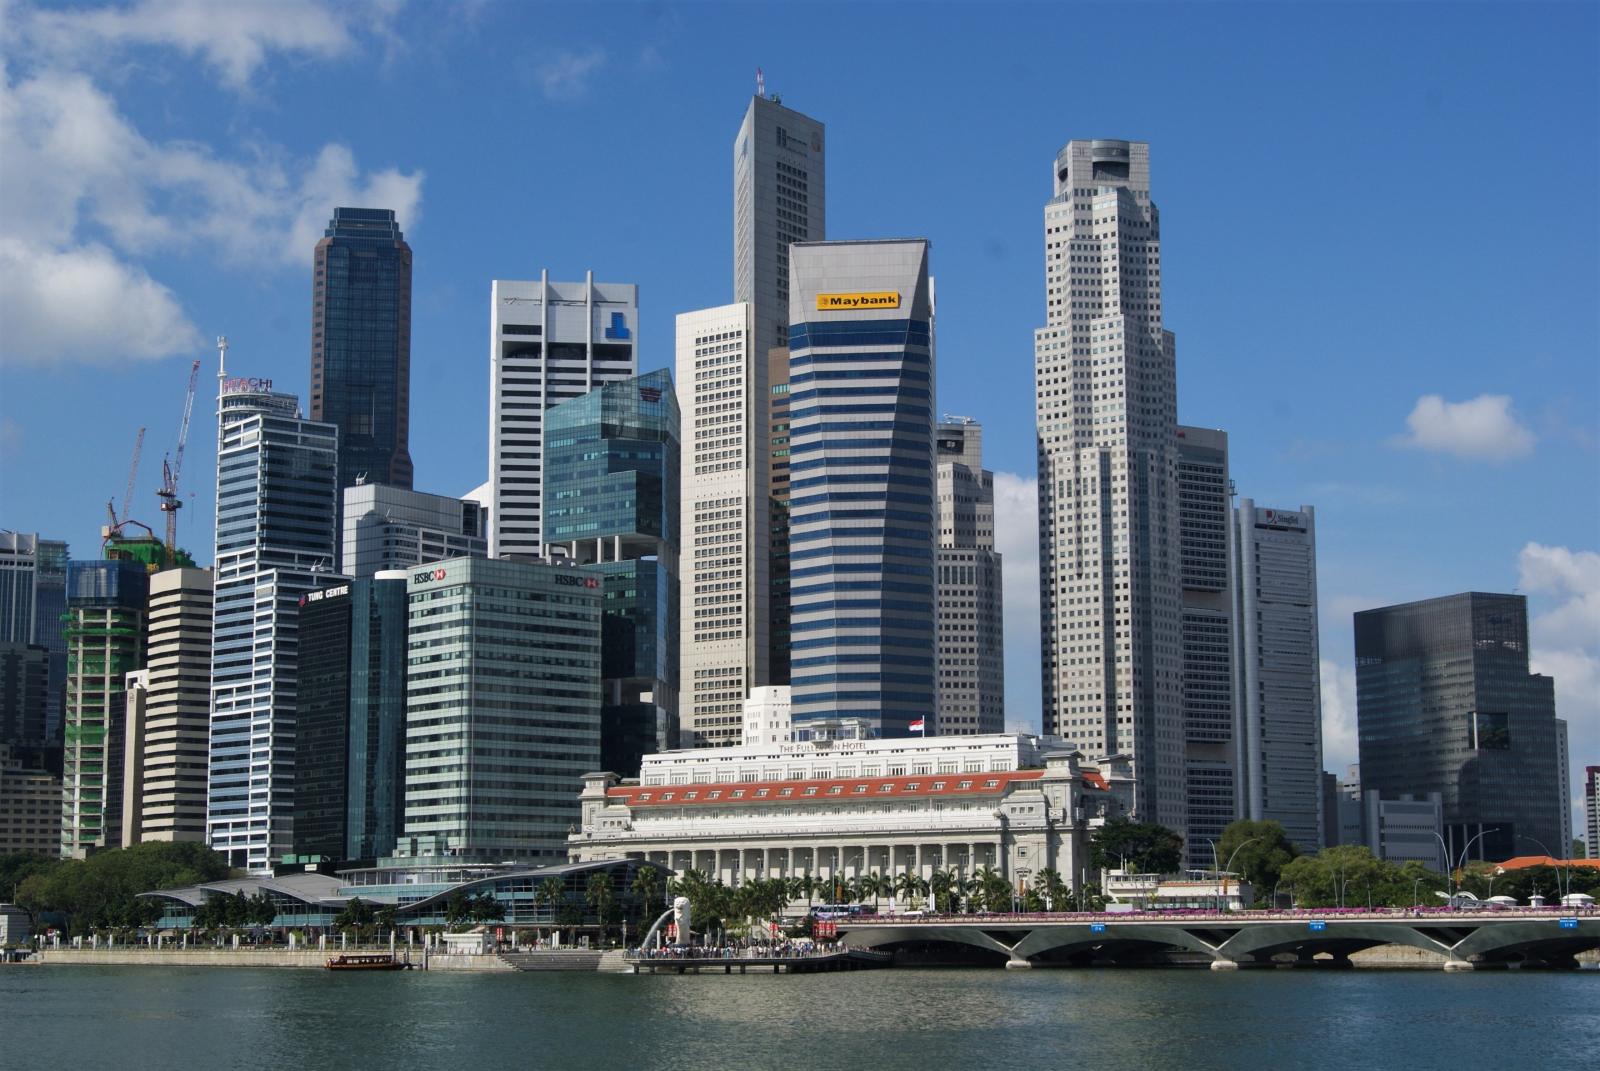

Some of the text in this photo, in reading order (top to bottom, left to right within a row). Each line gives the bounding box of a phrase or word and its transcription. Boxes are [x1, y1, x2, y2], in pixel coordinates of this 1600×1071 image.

[830, 296, 896, 306] Maybank
[223, 377, 272, 390] HITACHI
[414, 571, 434, 584] HSBC
[555, 574, 583, 587] HSBC
[325, 585, 349, 598] CENTRE
[779, 745, 794, 753] THE
[842, 742, 867, 750] HOTEL
